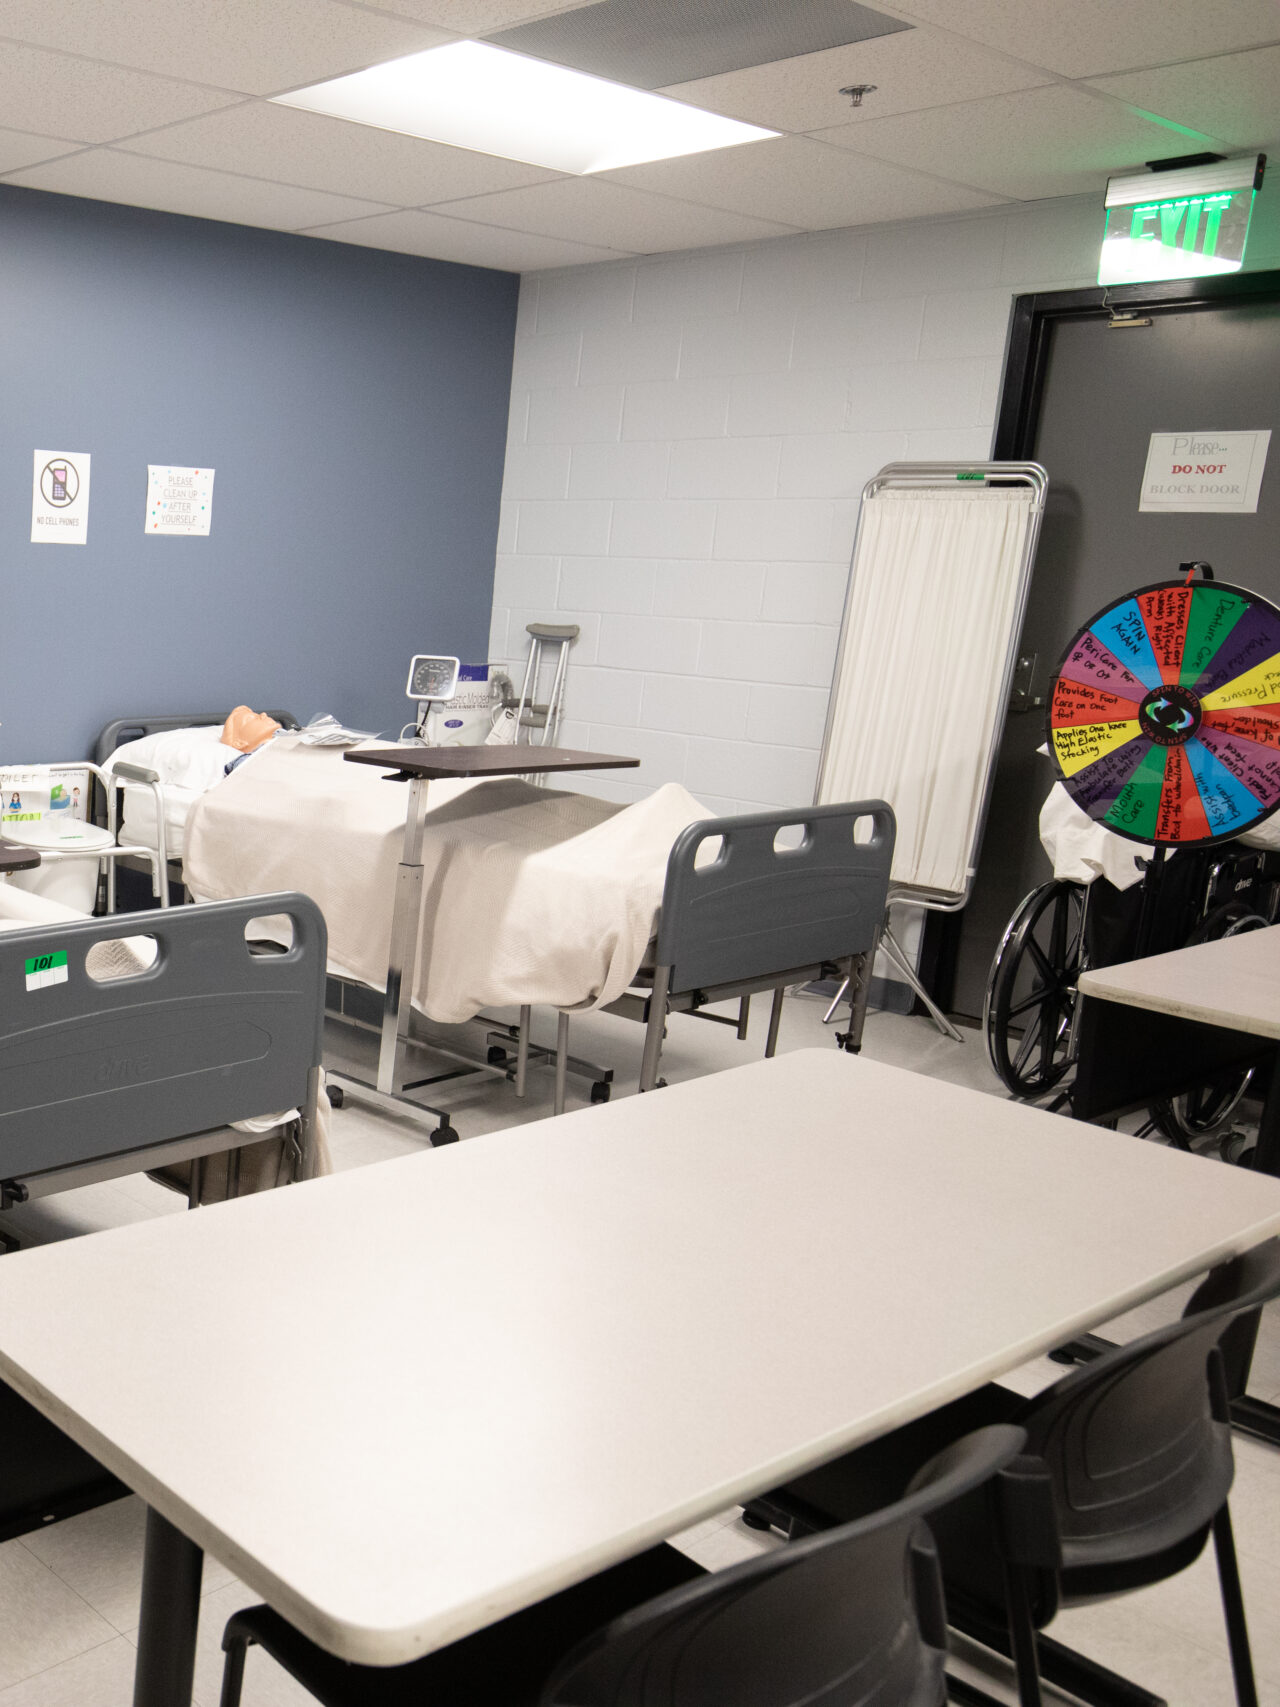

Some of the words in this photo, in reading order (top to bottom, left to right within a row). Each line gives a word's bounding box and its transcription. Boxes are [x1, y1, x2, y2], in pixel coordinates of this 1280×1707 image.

[1171, 464, 1192, 474] DO
[1195, 464, 1226, 474] NOT
[168, 476, 193, 486] PLEASE
[1150, 485, 1196, 494] BLOCK
[1200, 485, 1240, 494] DOOR
[163, 489, 186, 498] CLEAN
[188, 489, 198, 498] UP
[168, 502, 191, 511] AFTER
[37, 517, 44, 525] NO
[45, 517, 58, 525] CELL
[59, 517, 79, 526] PHONES
[161, 515, 197, 524] YOURSELF
[1146, 596, 1154, 618] Arm
[1166, 592, 1176, 617] with
[1176, 591, 1189, 630] Dresses
[1123, 611, 1146, 643] SPIN
[1204, 598, 1235, 642] Denture
[1111, 623, 1141, 656] AGAIN
[1152, 625, 1162, 650] Right
[1162, 621, 1175, 666] Affected
[1174, 635, 1184, 668] Client
[1192, 646, 1211, 668] Care
[1057, 681, 1095, 699] Provides
[1221, 684, 1268, 703] Pressure
[1054, 697, 1073, 708] Care
[1055, 740, 1076, 754] High
[1078, 734, 1112, 746] Elastic
[1056, 729, 1087, 741] Applies
[1061, 746, 1100, 760] Stocking
[1219, 753, 1244, 777] Client
[1110, 782, 1137, 819] Mouth
[1122, 799, 1144, 824] Care
[1205, 795, 1229, 828] Assist
[1157, 788, 1172, 838] Transfers
[33, 955, 53, 971] 101
